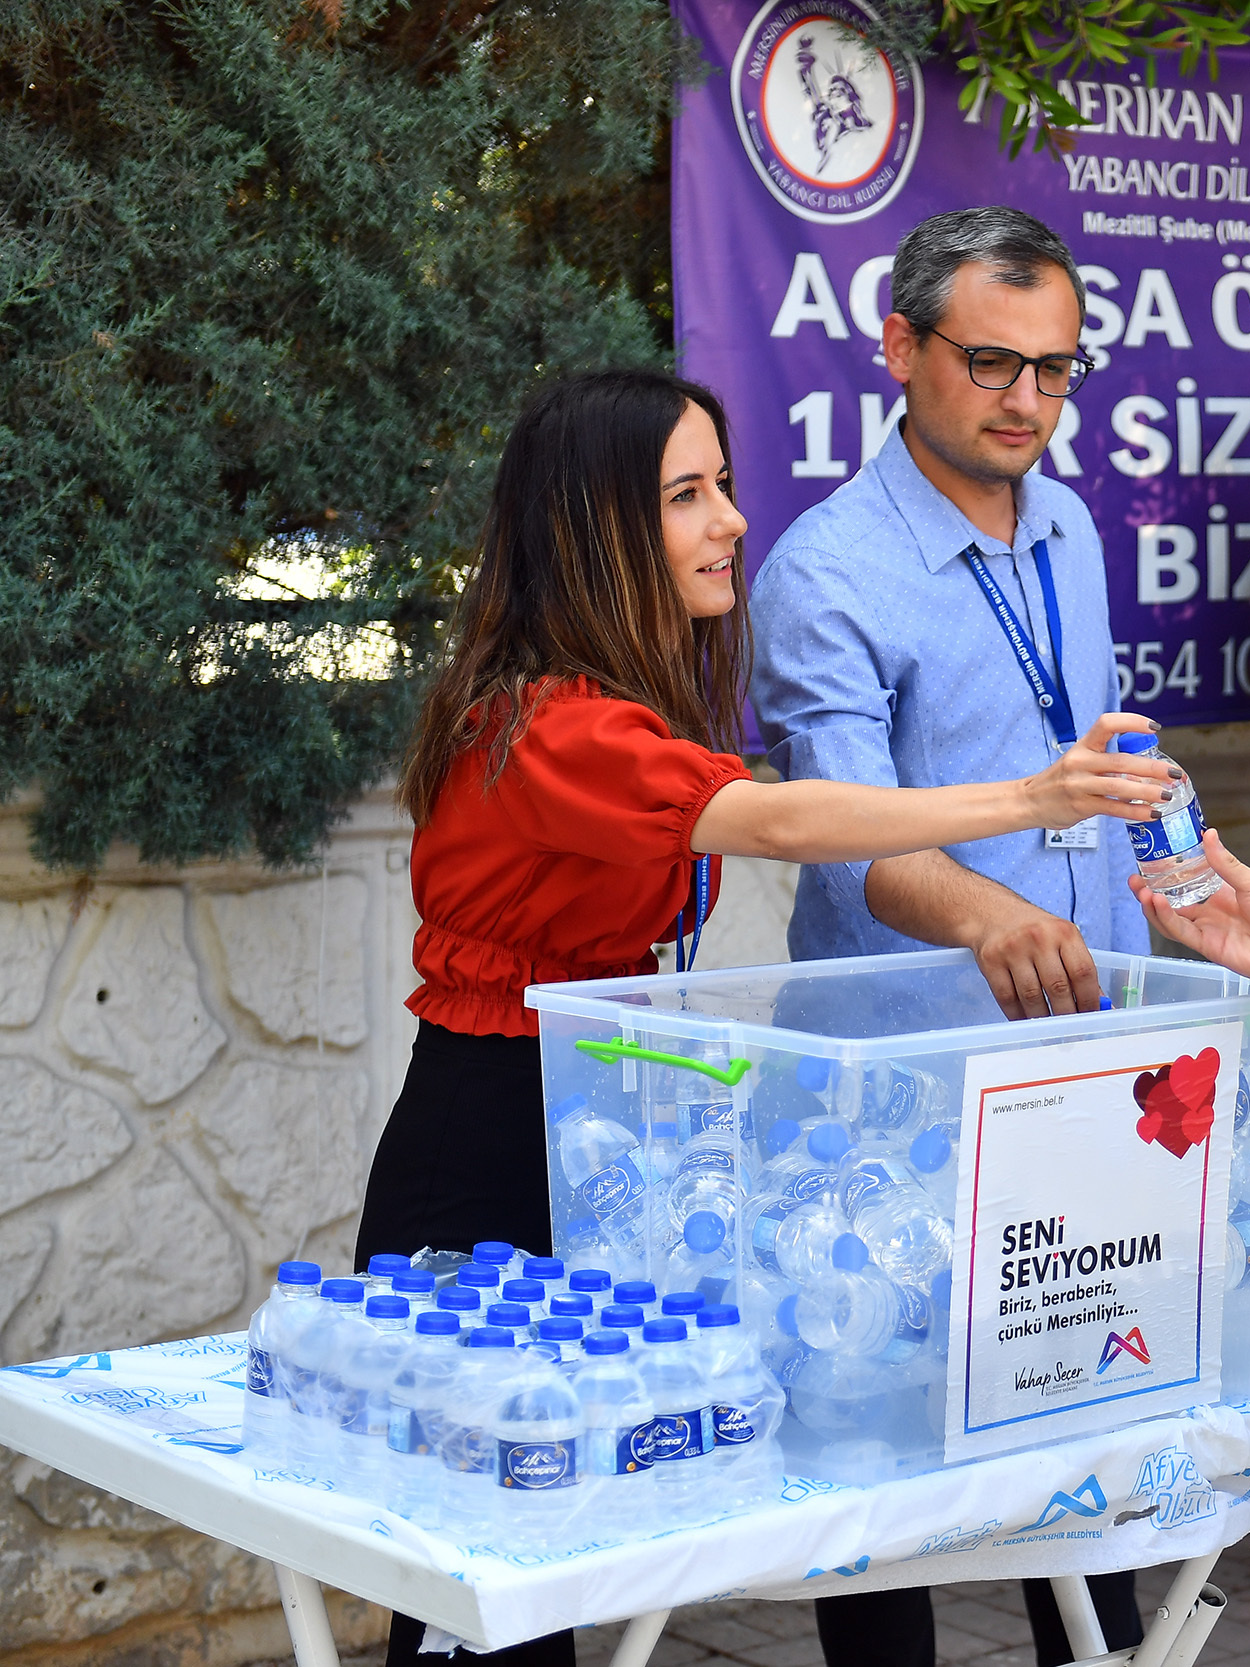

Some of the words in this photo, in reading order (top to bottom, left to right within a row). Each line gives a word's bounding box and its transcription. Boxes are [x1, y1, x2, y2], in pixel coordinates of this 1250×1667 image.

[1062, 153, 1200, 199] YABANCI
[788, 390, 849, 479] 1
[992, 1095, 1065, 1115] www.mersin.bel.tr
[999, 1296, 1037, 1317] Biriz,
[1041, 1279, 1118, 1308] beraberiz,
[998, 1318, 1042, 1346] çünkü
[1014, 1366, 1051, 1397] Vahap
[1053, 1361, 1084, 1383] Seçer
[1066, 1528, 1103, 1539] BELEDİYESİ
